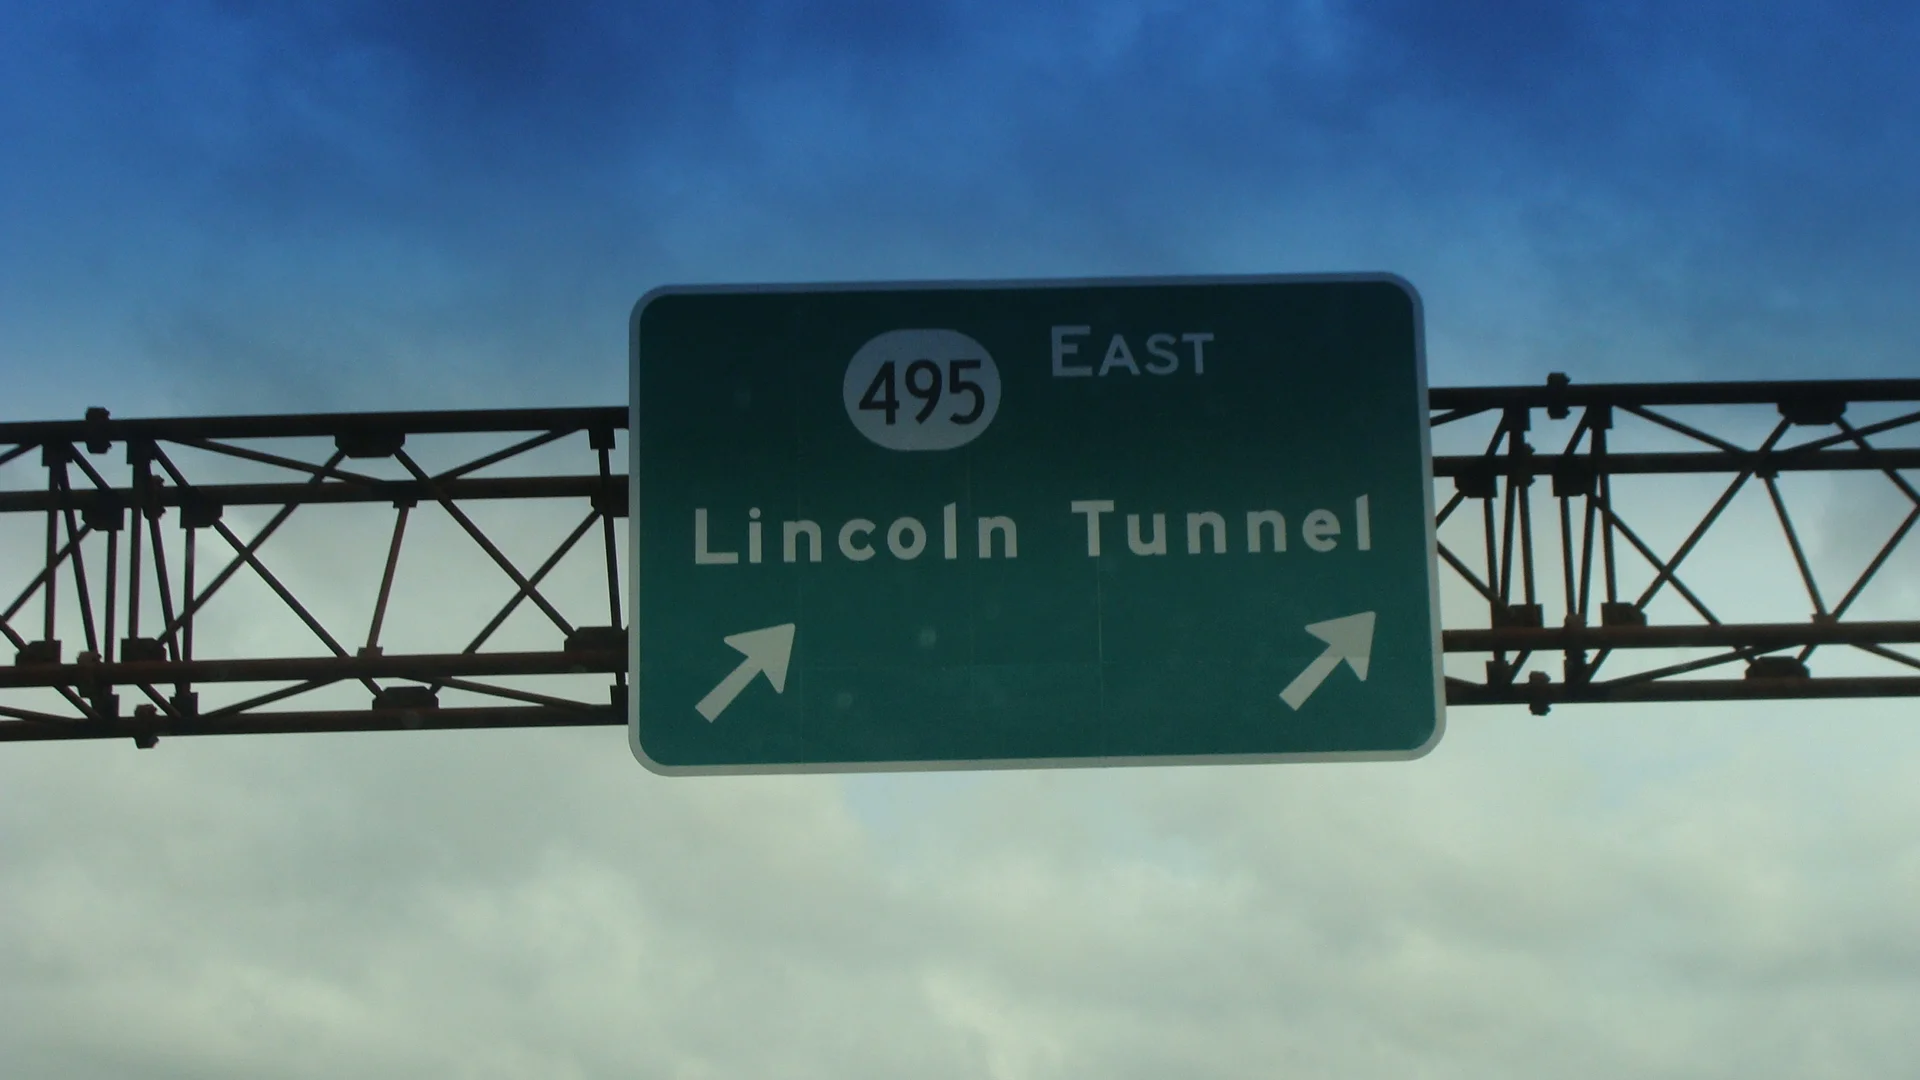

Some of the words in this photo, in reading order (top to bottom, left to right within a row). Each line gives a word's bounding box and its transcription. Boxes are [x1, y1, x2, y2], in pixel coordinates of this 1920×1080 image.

[1051, 325, 1214, 378] EAST
[858, 359, 985, 426] 495
[695, 503, 1018, 565] Lincoln
[1071, 495, 1371, 557] Tunnel
